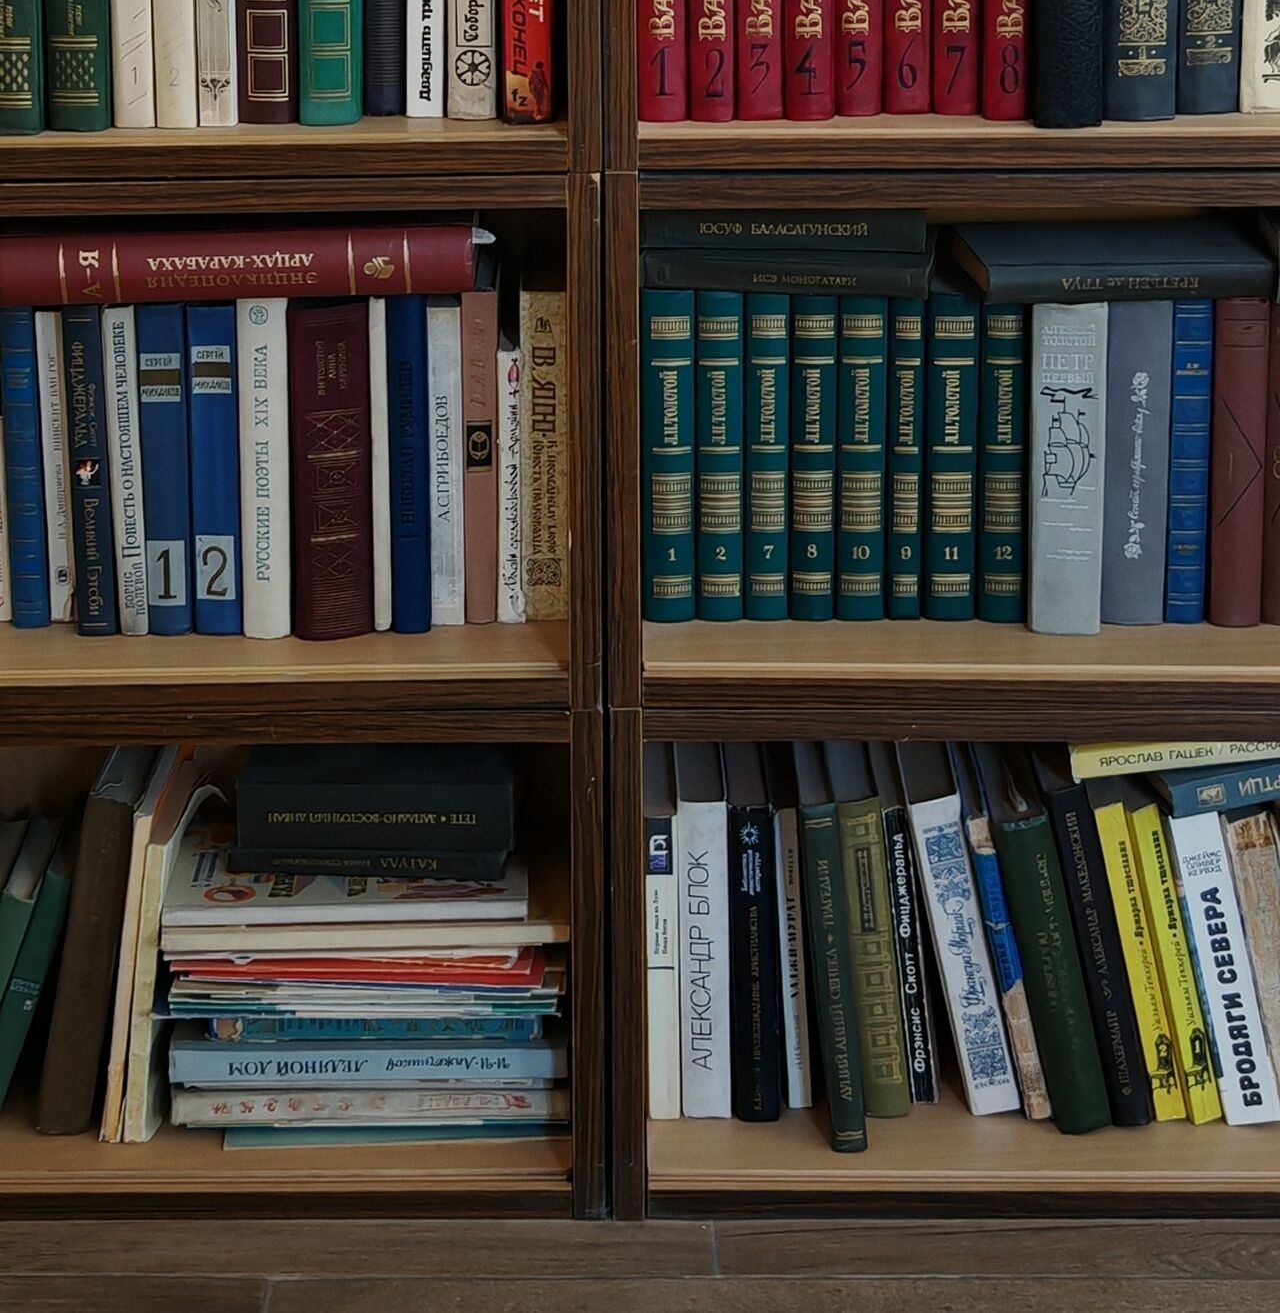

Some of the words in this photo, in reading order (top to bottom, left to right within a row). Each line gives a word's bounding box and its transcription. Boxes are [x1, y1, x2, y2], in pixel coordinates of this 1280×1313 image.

[463, 0, 485, 43] Собор
[418, 26, 434, 102] Двадцать
[649, 47, 673, 96] 1
[703, 48, 725, 98] 2
[748, 42, 770, 95] 3
[700, 222, 743, 235] ЮСУФ
[145, 271, 318, 289] ЭНЦИКЛОПЕДИЯ
[147, 252, 315, 271] АРЦАХ-КАРАБАХА
[1061, 276, 1103, 291] ТРУА
[112, 322, 128, 389] ЧЕЛОВЕКЕ
[252, 343, 268, 390] ВЕКА
[116, 390, 133, 477] НАСТОЯЩЕМ
[254, 440, 269, 500] ПОЭТЫ
[255, 506, 270, 583] РУССКИЕ
[155, 549, 178, 601] 1
[201, 546, 228, 598] 2
[1099, 750, 1163, 768] ЯРОСЛАВ
[1168, 746, 1214, 761] ГАШЕК
[451, 813, 477, 825] ГЕТЕ
[686, 850, 710, 916] БЛОК
[892, 832, 911, 938] Фицджеральд
[1199, 886, 1240, 985] СЕВЕРА
[689, 926, 715, 1072] АЛЕКСАНДР
[902, 952, 918, 994] Скотт
[908, 1007, 927, 1073] Фрэнсис
[1221, 991, 1263, 1108] БРОДЯГИ
[227, 1061, 272, 1076] ДОМ
[275, 1061, 369, 1077] ЛЕДЯНОЙ
